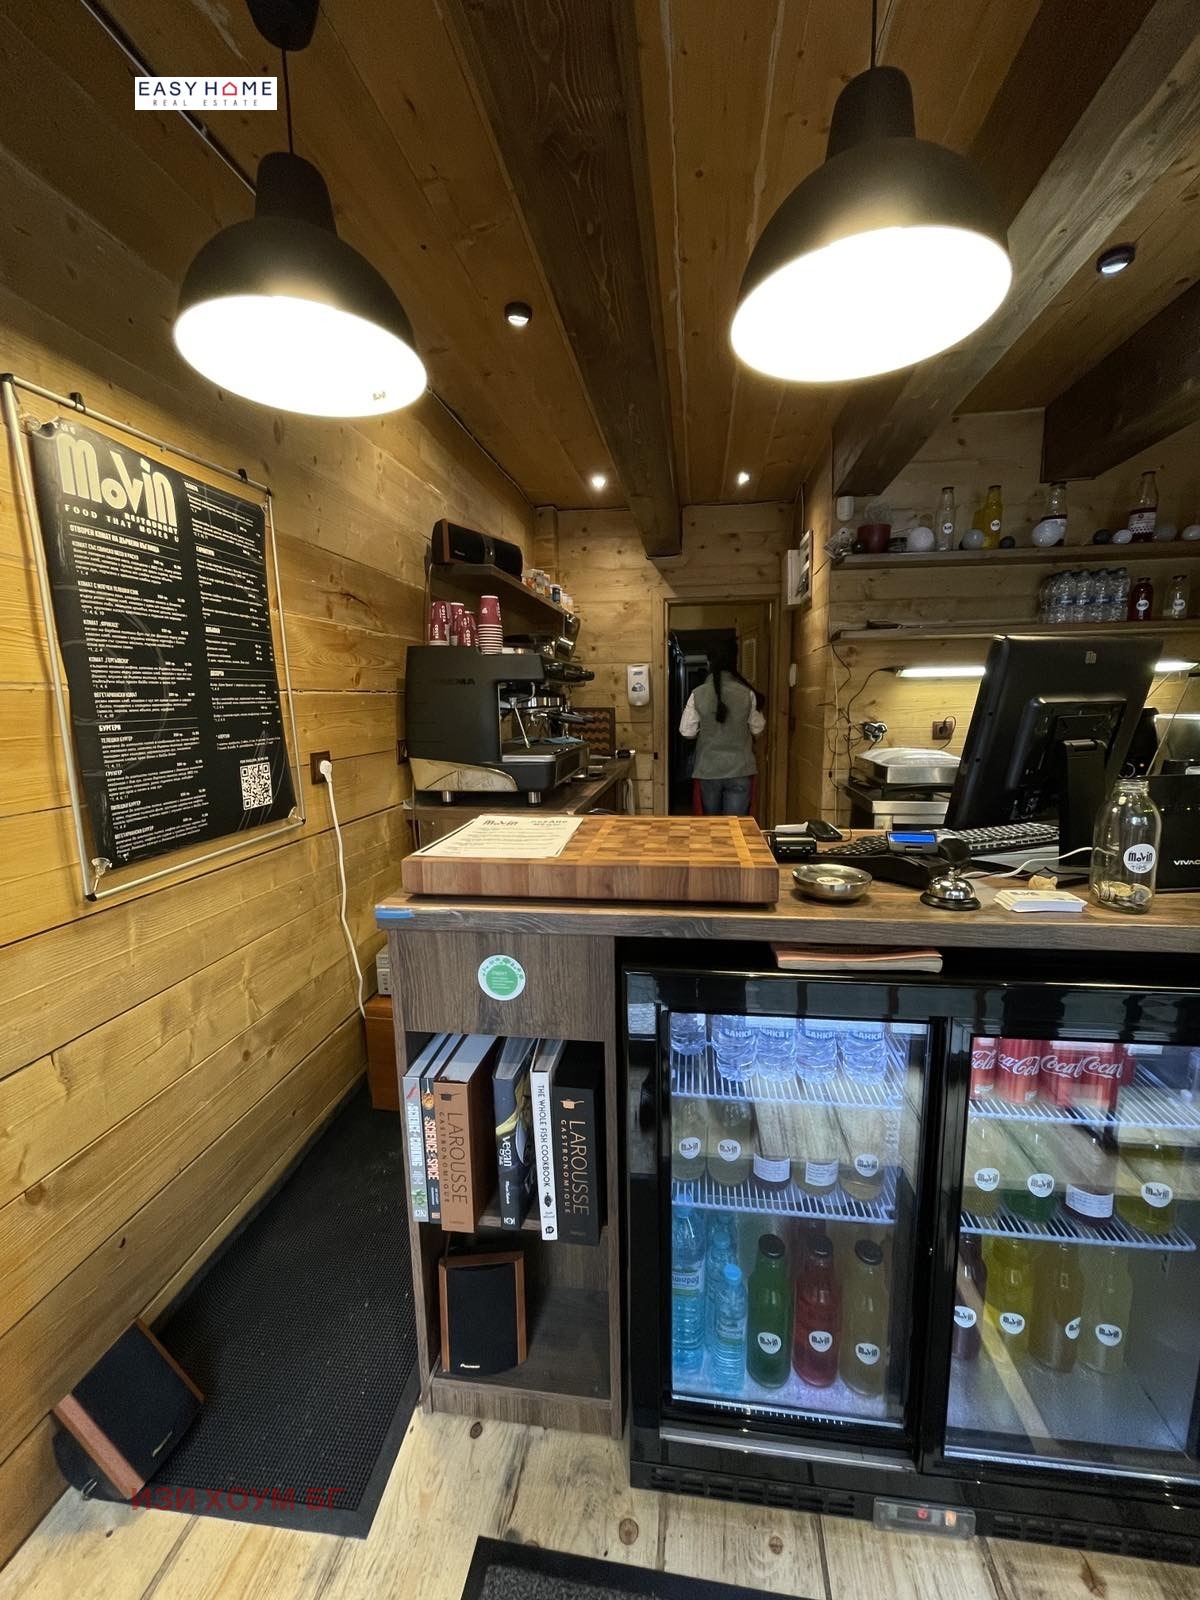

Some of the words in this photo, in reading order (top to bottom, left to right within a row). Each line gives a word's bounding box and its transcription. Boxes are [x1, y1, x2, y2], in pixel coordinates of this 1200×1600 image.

[64, 503, 98, 519] FOOD
[105, 515, 132, 529] THAT
[139, 525, 169, 540] MOVES
[537, 1084, 545, 1098] THE
[538, 1100, 548, 1126] WHOLE
[424, 1119, 437, 1153] SCIENCE
[502, 1135, 513, 1167] vegan
[540, 1127, 548, 1143] FISH
[427, 1158, 440, 1181] SPICE
[439, 1111, 450, 1203] GASTRONOMIQUE
[447, 1112, 468, 1205] LAROUSSE
[541, 1145, 551, 1188] COOKBOOK
[560, 1119, 571, 1214] GASTRONOMIQUE
[569, 1119, 590, 1216] LAROUSSE
